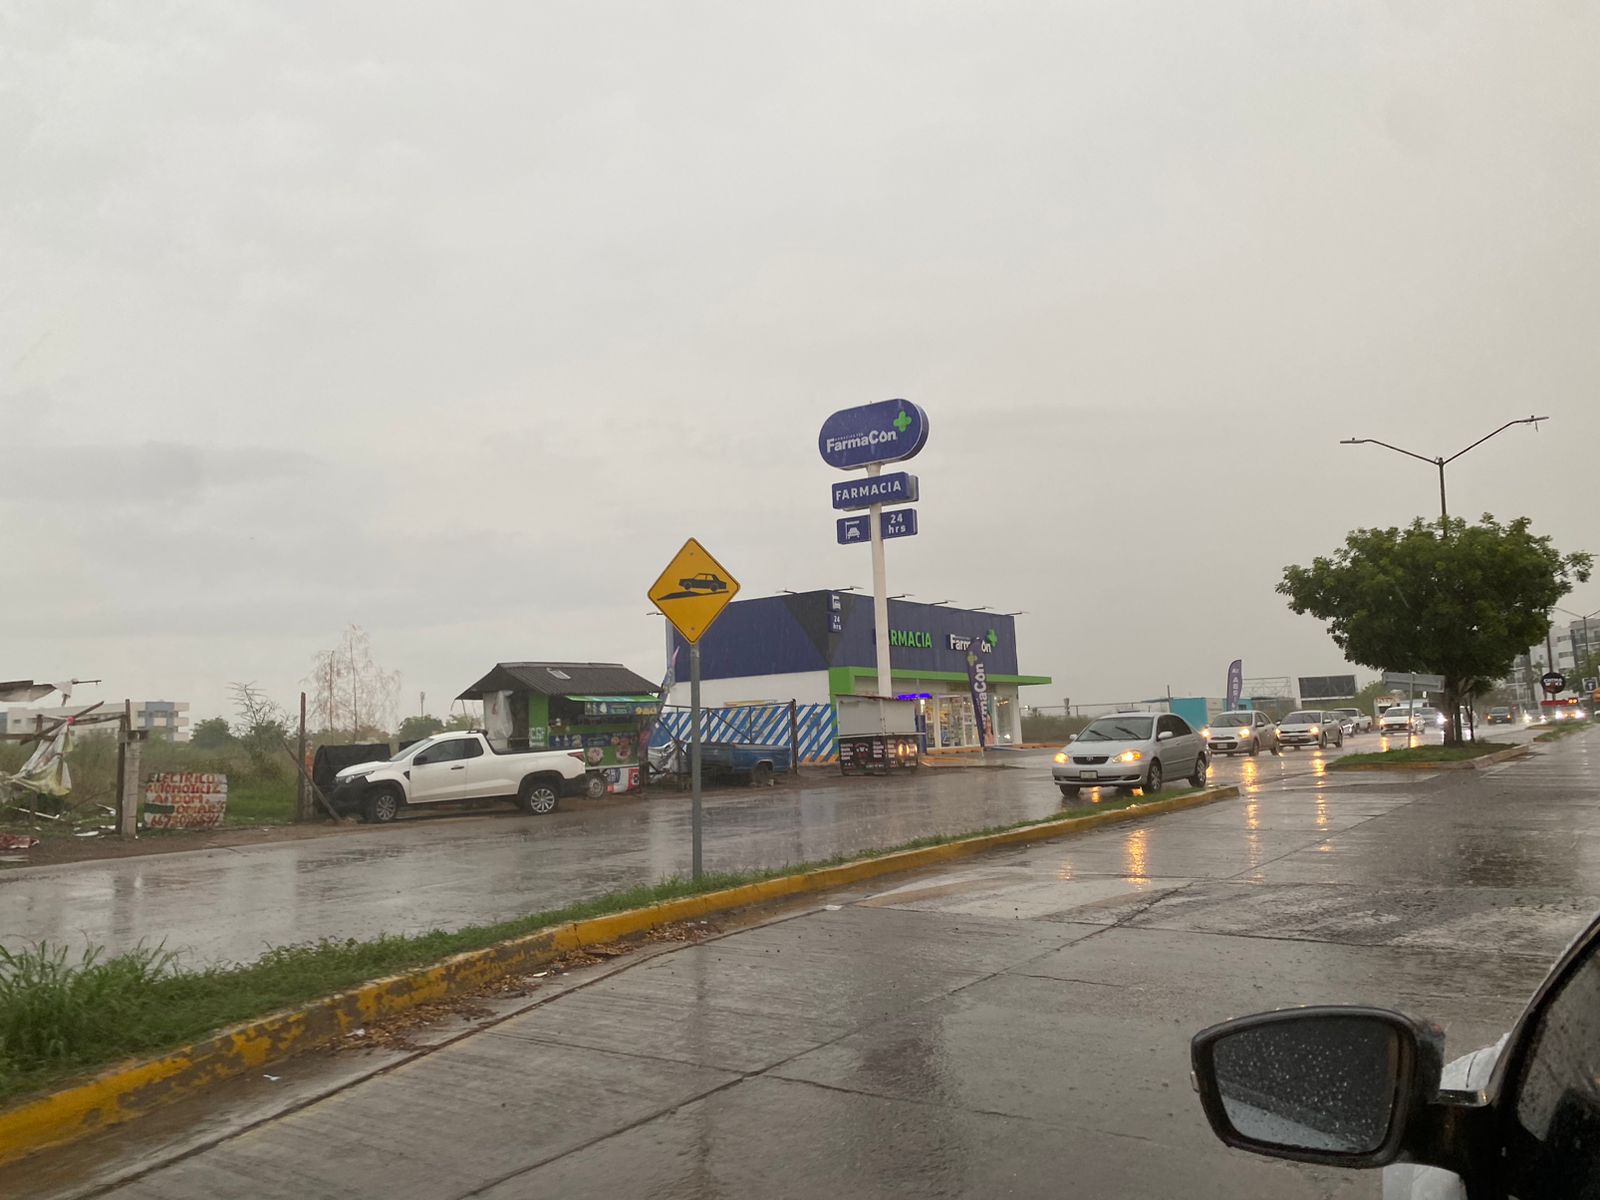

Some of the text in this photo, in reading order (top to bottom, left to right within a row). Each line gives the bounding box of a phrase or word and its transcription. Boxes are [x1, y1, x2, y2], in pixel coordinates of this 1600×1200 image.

[826, 429, 897, 454] FarmaCon
[835, 480, 902, 502] FARMACIA
[890, 513, 903, 524] 24
[888, 524, 907, 535] hrs
[833, 615, 841, 623] 24
[890, 629, 933, 648] RMACIA
